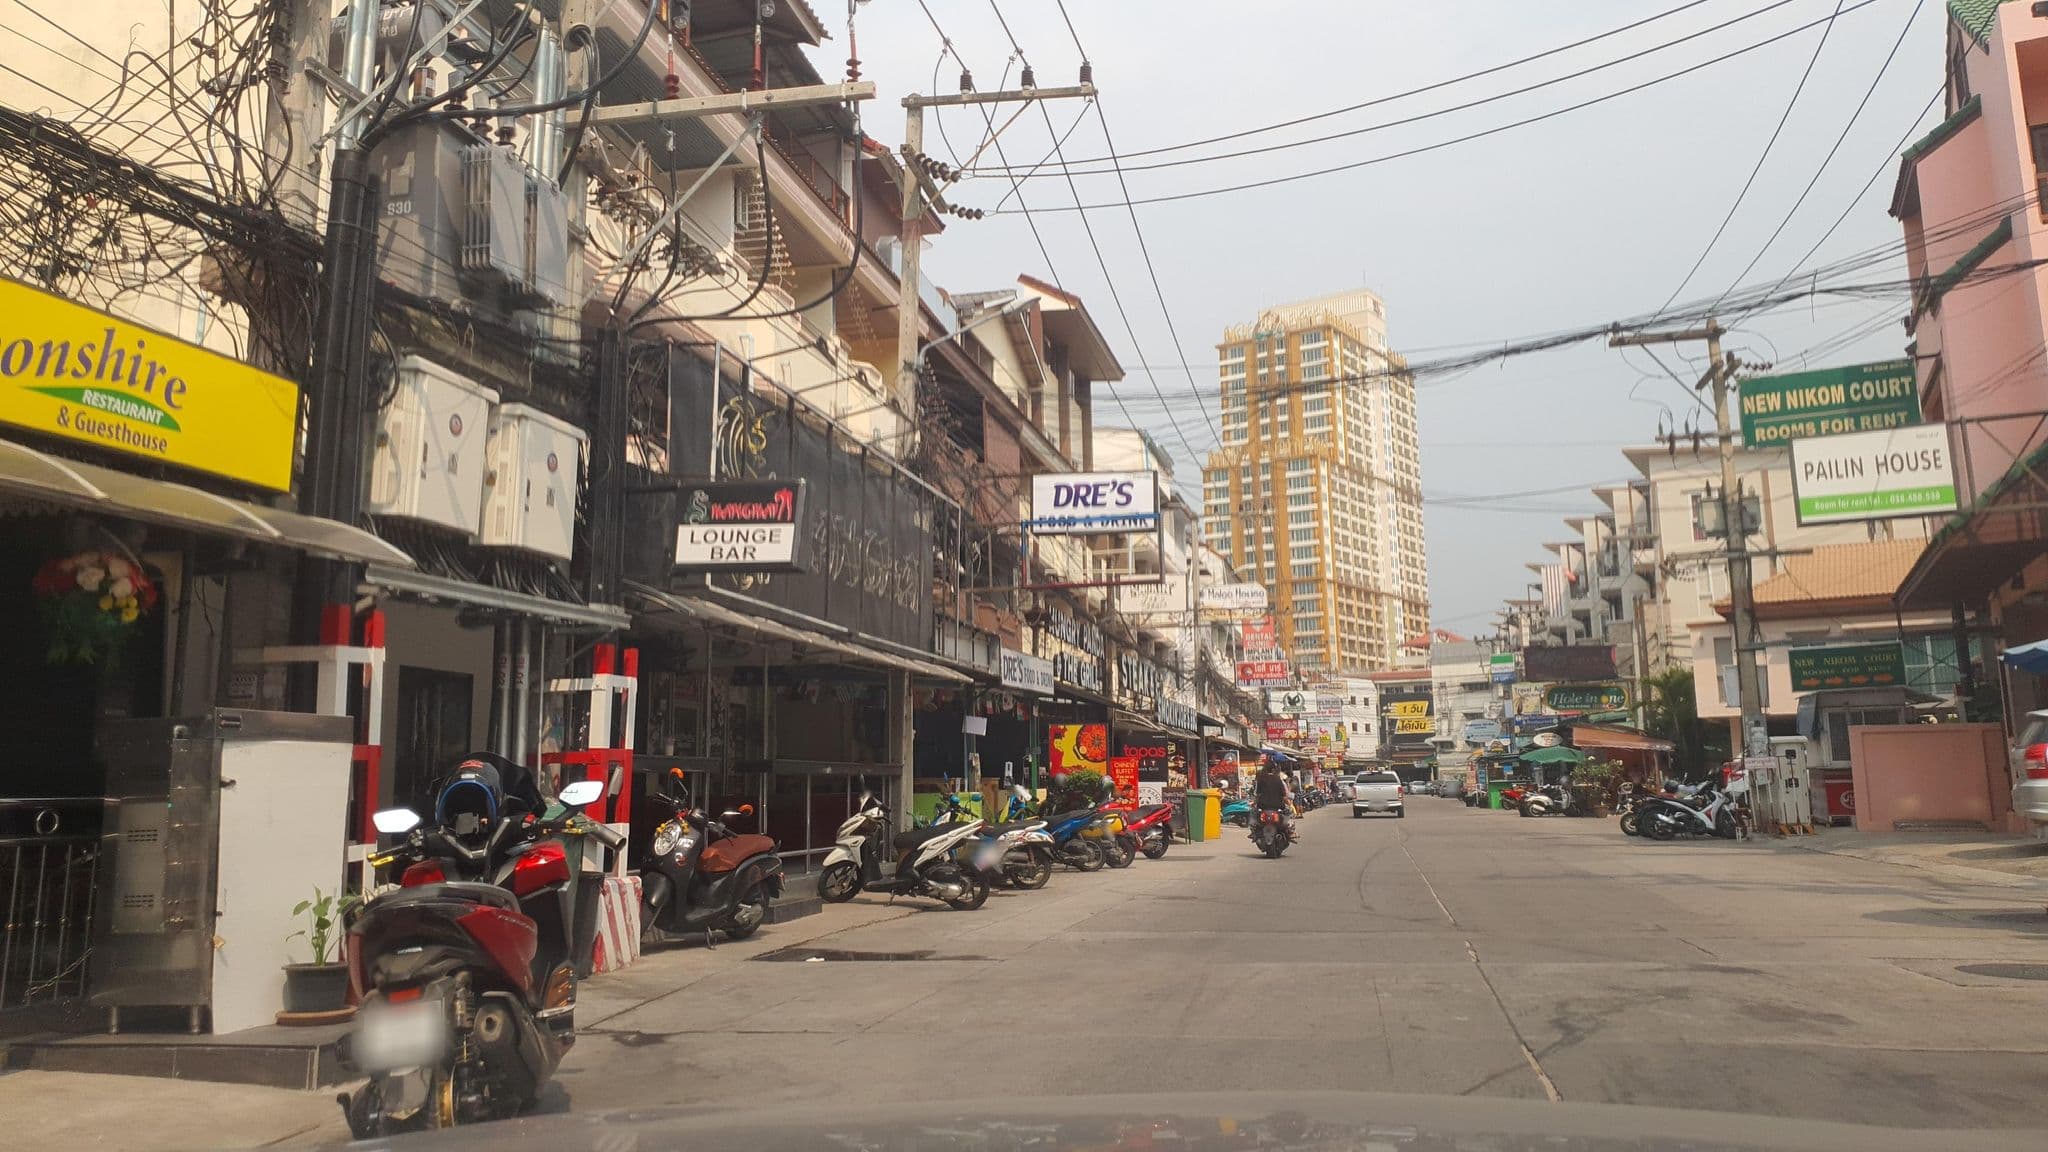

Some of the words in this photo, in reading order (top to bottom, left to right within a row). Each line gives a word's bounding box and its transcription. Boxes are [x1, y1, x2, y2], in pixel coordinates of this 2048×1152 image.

[82, 389, 165, 425] RESTAURANT
[1743, 391, 1781, 415] NEW
[1786, 383, 1846, 410] NIKOM
[1850, 376, 1913, 401] COURT
[57, 405, 69, 427] &
[75, 410, 168, 453] Guesthouse
[1755, 421, 1817, 442] ROOMS
[1821, 417, 1856, 435] FOR
[1860, 411, 1909, 430] RENT
[1804, 456, 1864, 482] PAILIN
[1875, 449, 1942, 475] HOUSE
[1053, 481, 1134, 507] DRE'S
[690, 528, 782, 545] LOUNGE
[710, 546, 757, 560] BAR
[1048, 604, 1080, 648] HUNGRY
[1083, 623, 1105, 660] PANDA
[1003, 655, 1024, 682] DRE'S
[1063, 653, 1078, 684] THE
[1081, 661, 1103, 695] GRILL
[1553, 693, 1582, 705] Hole
[1123, 744, 1166, 760] tapas
